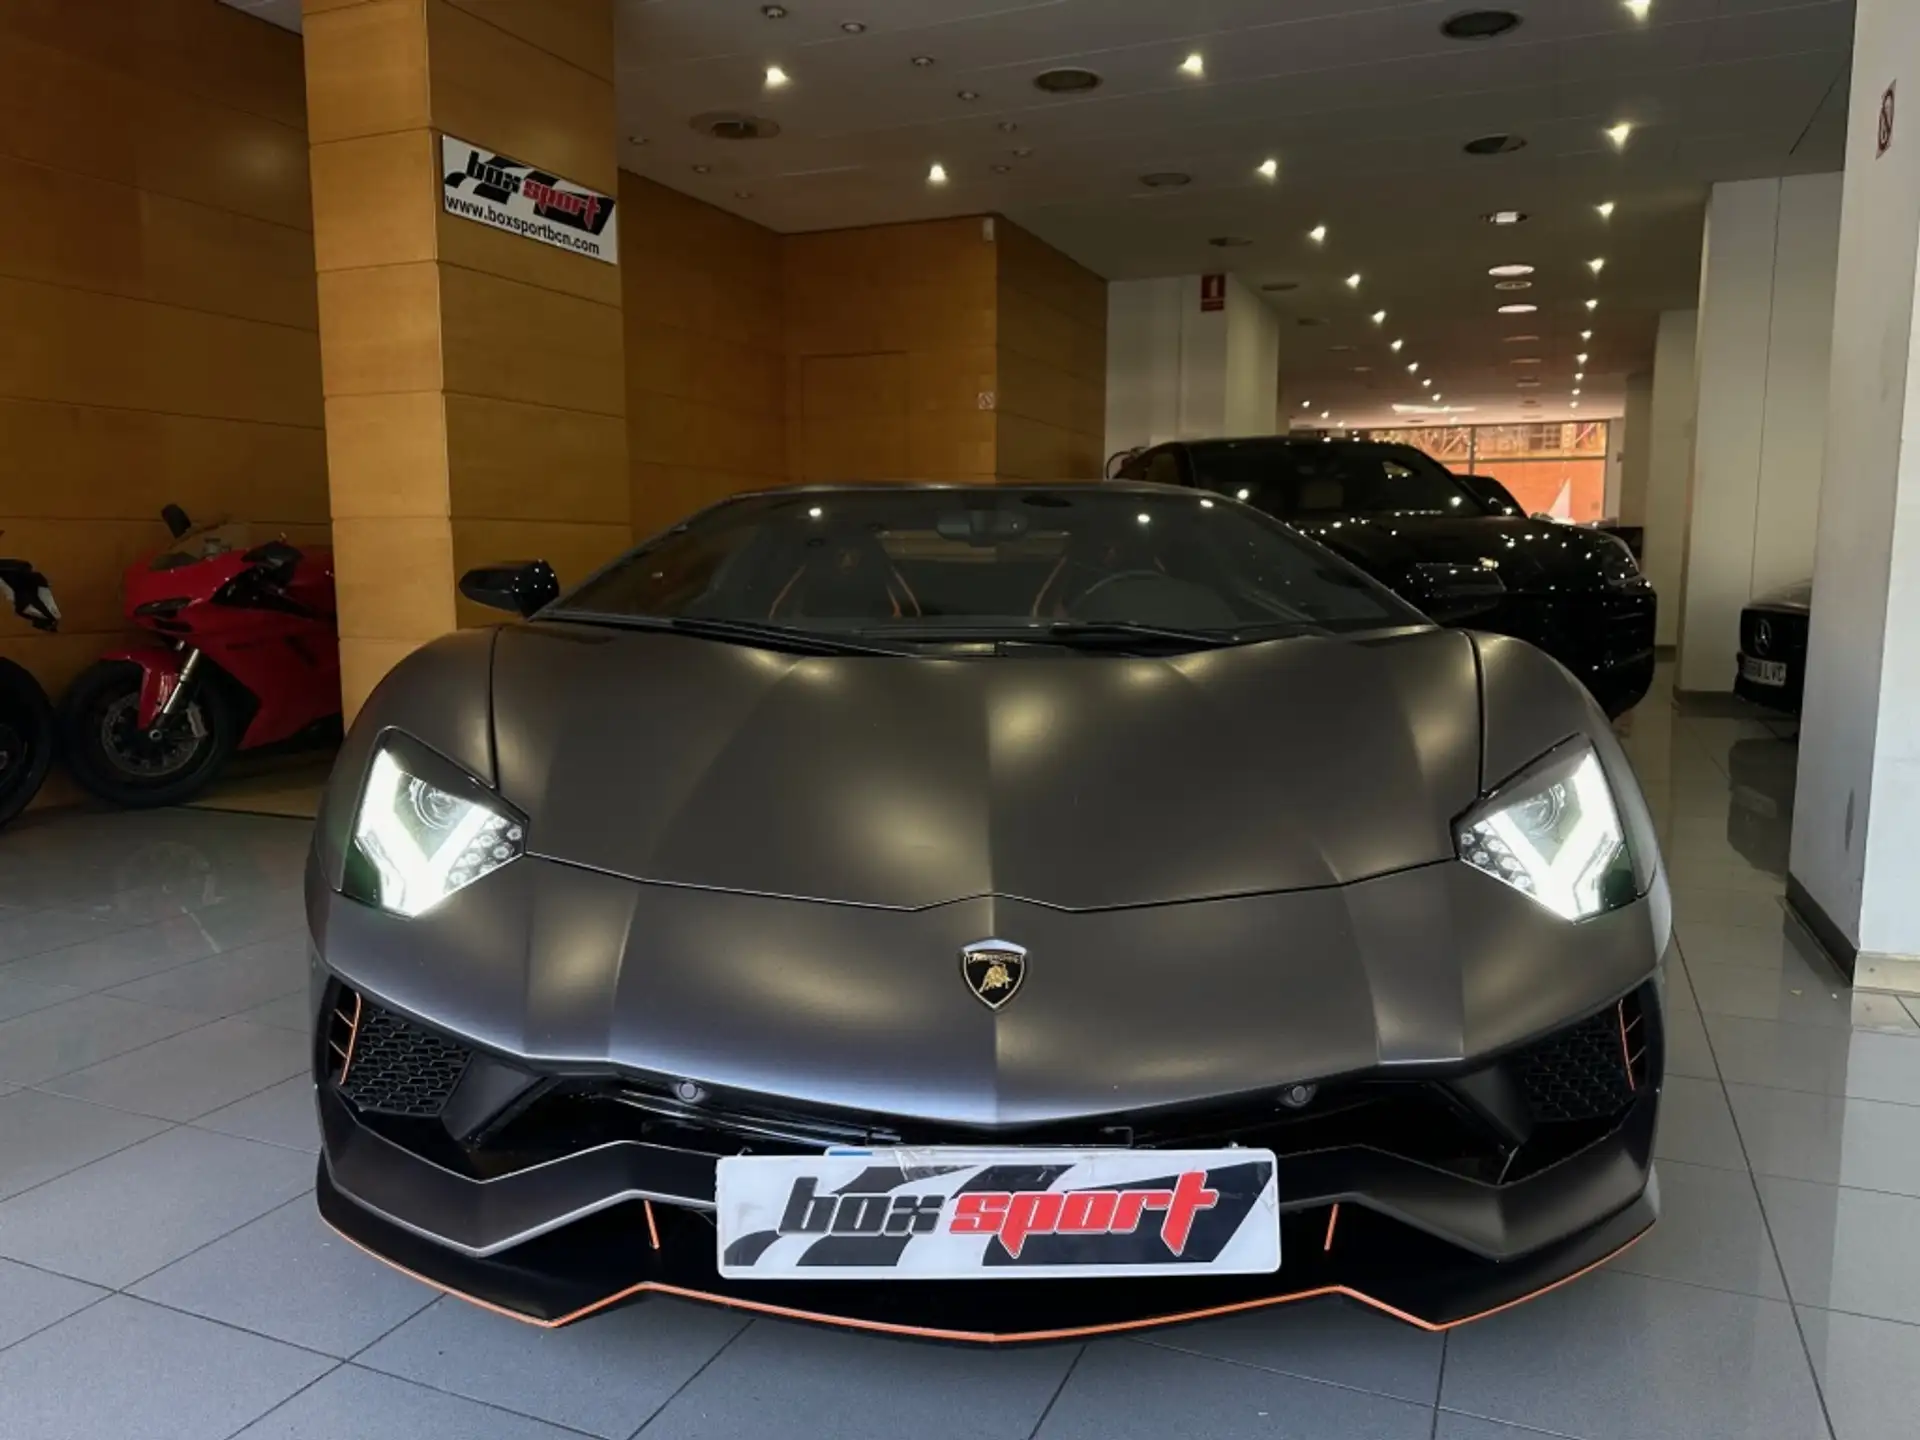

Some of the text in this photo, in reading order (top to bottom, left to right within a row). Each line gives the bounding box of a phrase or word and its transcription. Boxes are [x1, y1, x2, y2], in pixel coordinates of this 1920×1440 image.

[446, 194, 601, 255] www.boxsportbcn.com
[466, 150, 601, 231] box sport
[777, 1170, 1220, 1259] box sport
